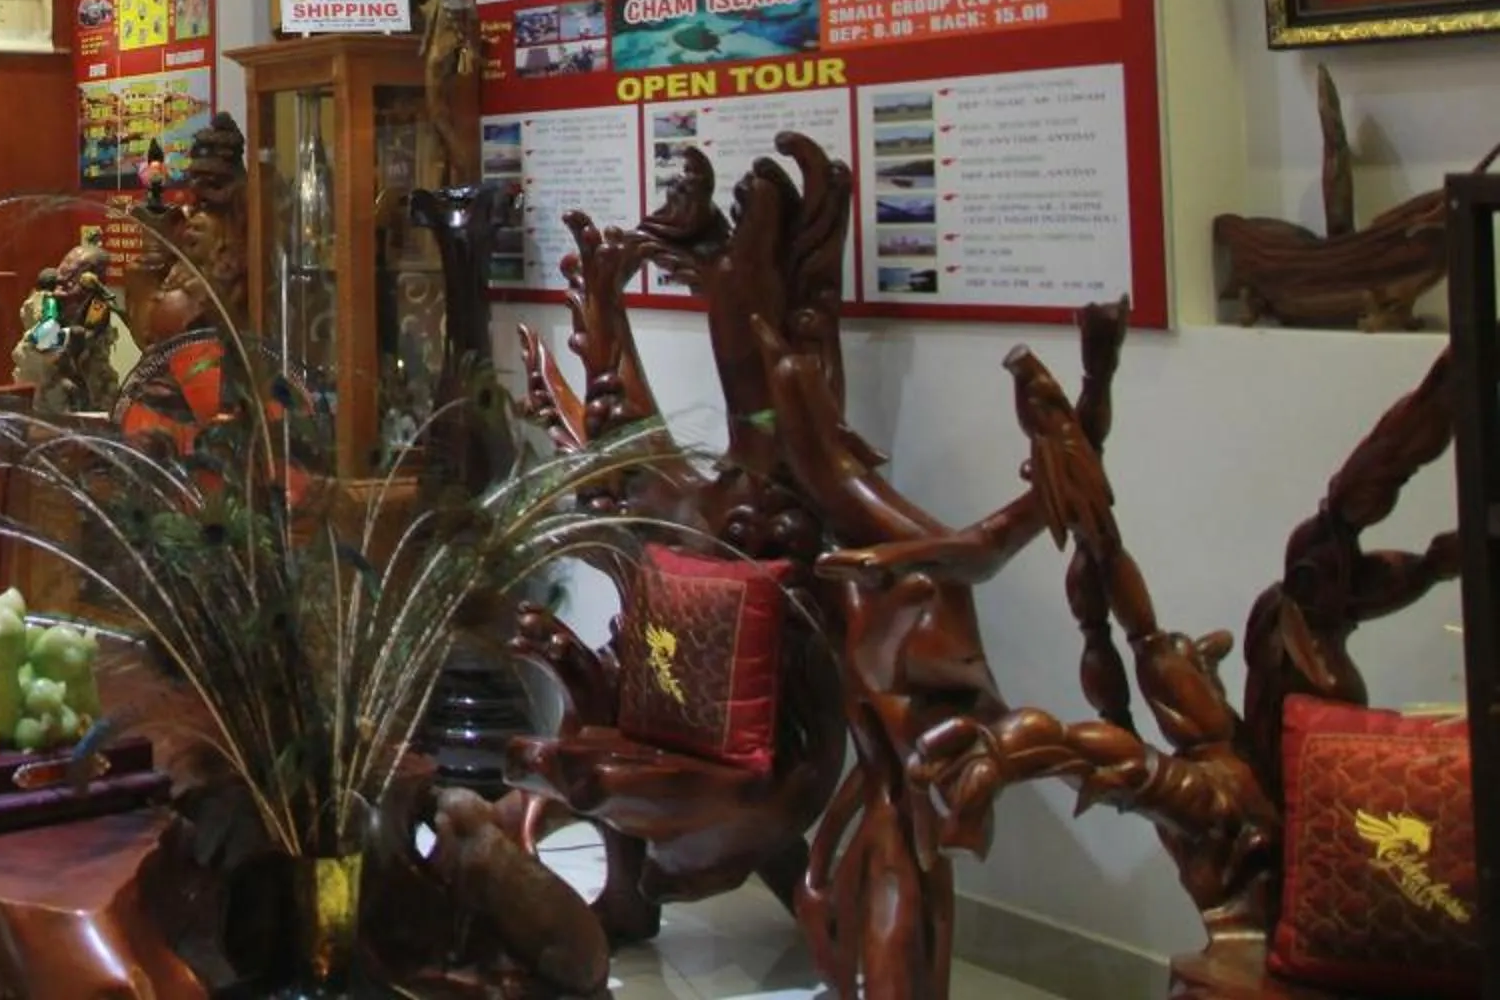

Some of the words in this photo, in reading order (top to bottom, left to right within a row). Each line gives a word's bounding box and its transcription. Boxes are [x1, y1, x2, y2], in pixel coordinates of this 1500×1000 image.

[292, 3, 399, 18] SHIPPING
[828, 4, 885, 24] SMALL
[829, 24, 868, 44] DEP:
[930, 12, 987, 32] BACK:
[995, 3, 1048, 23] 15.00
[616, 70, 717, 101] OPEN
[729, 57, 847, 92] TOUR
